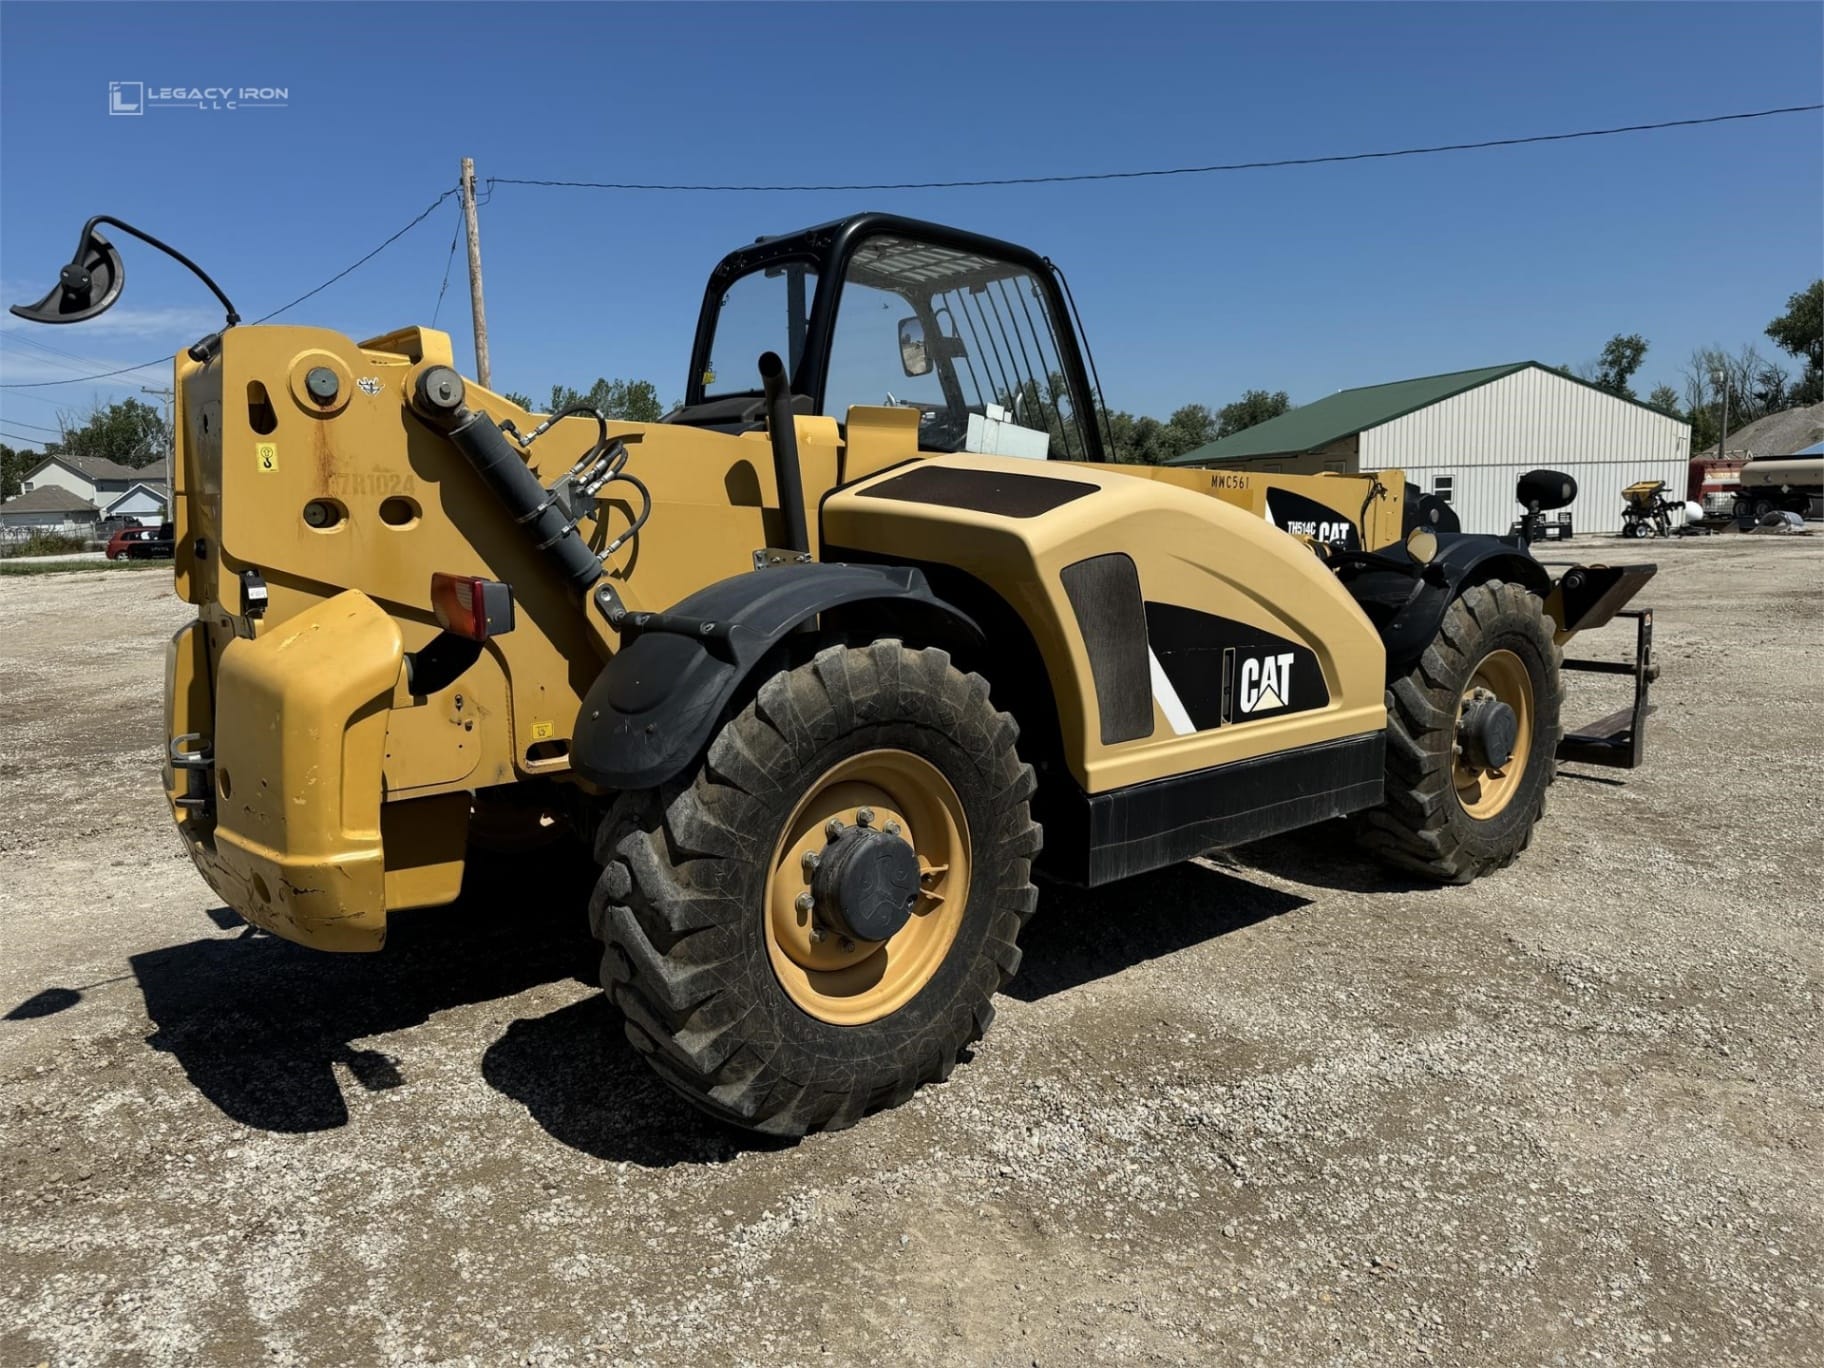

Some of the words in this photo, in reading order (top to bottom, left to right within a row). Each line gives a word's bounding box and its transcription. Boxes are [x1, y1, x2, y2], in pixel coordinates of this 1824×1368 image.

[1211, 475, 1249, 489] MWC561
[1288, 521, 1316, 535] TH514C
[1319, 522, 1349, 543] CAT
[1240, 653, 1294, 712] CAT
